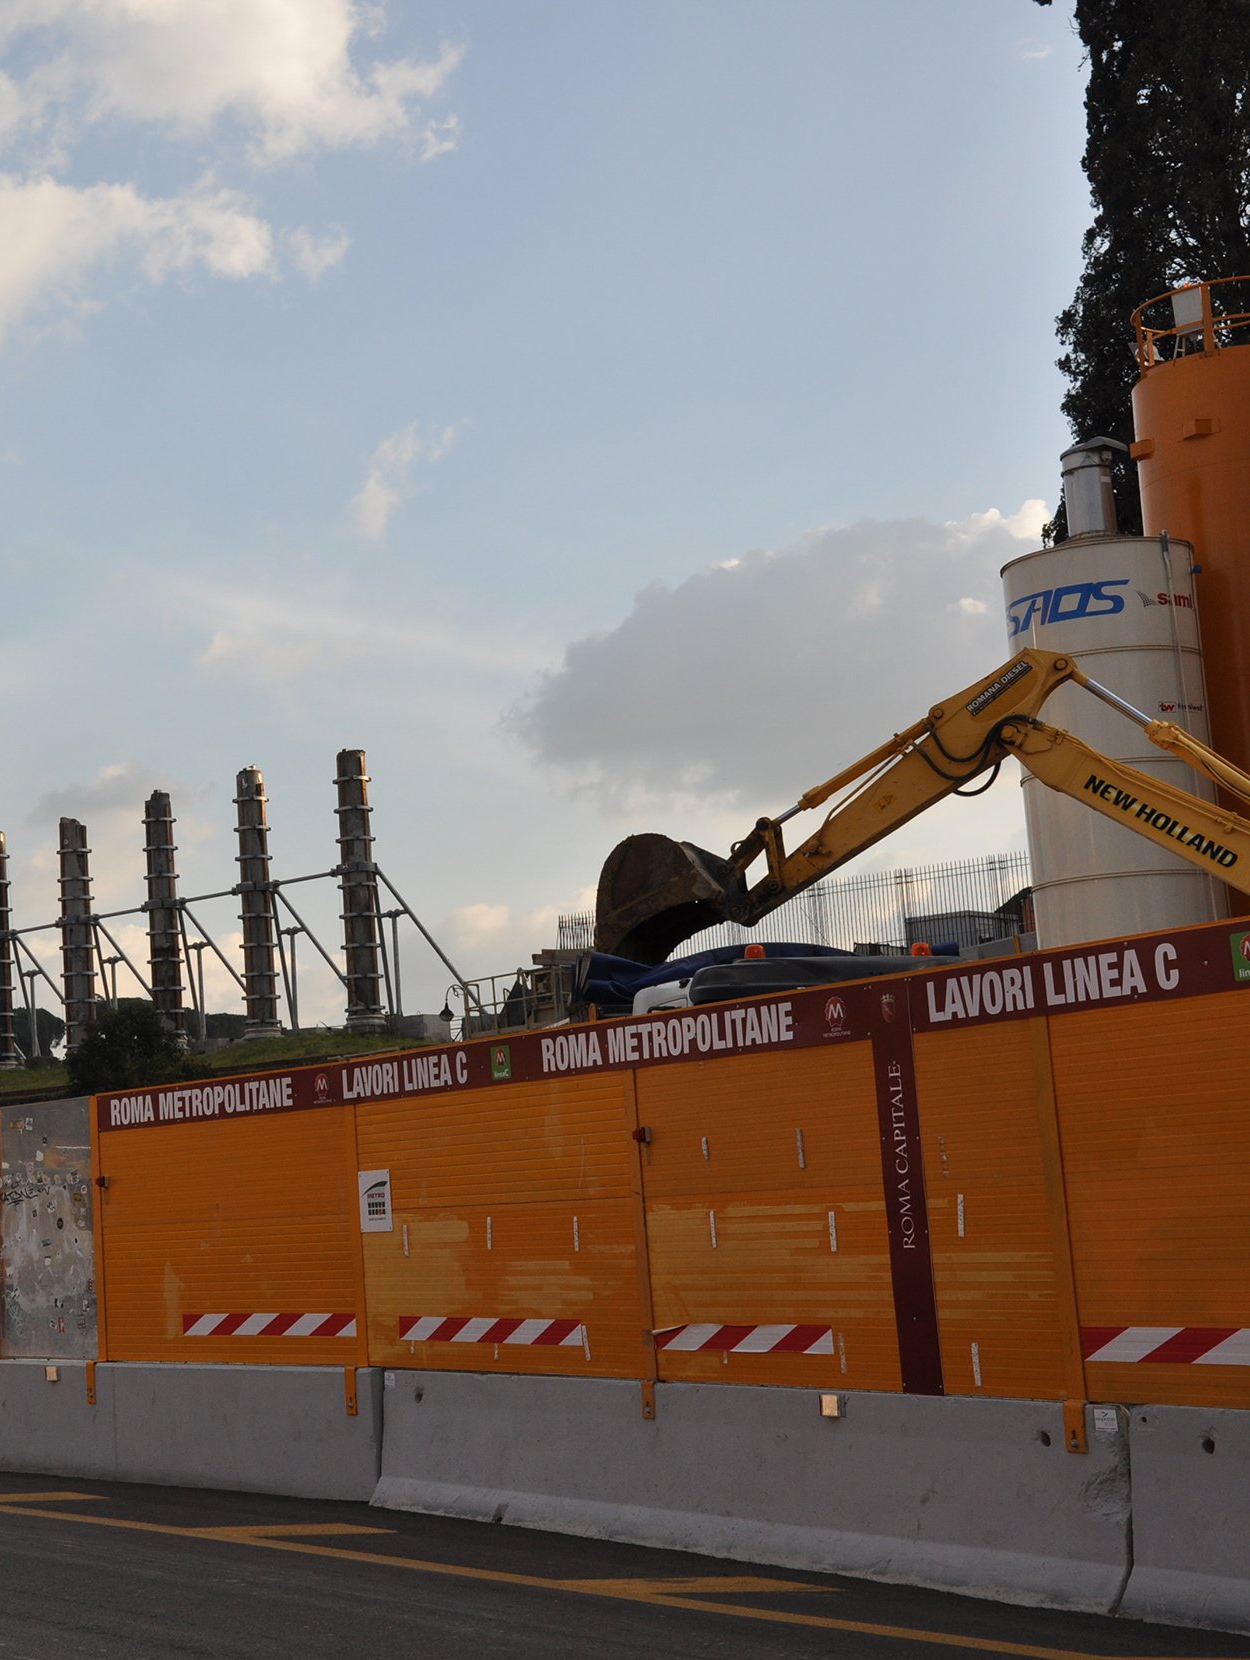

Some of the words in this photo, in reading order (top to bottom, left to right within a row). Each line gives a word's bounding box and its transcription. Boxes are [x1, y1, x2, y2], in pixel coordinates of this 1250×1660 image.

[967, 682, 1001, 711] ROMANA
[1000, 661, 1027, 684] DIESEL
[1084, 774, 1138, 811] NEW
[1135, 803, 1238, 868] HOLLAND
[926, 965, 1035, 1023] LAVORI
[1043, 949, 1147, 1006] LINEA
[1154, 942, 1180, 991] C
[541, 1032, 602, 1072] ROMA
[607, 1002, 794, 1064] METROPOLITANE
[110, 1095, 154, 1126] ROMA
[159, 1077, 293, 1120] METROPOLITANE
[342, 1062, 399, 1099] LAVORI
[403, 1054, 452, 1091] LINEA
[456, 1051, 468, 1084] C
[888, 1064, 909, 1174] CAPITALE
[898, 1179, 915, 1248] ROMA
